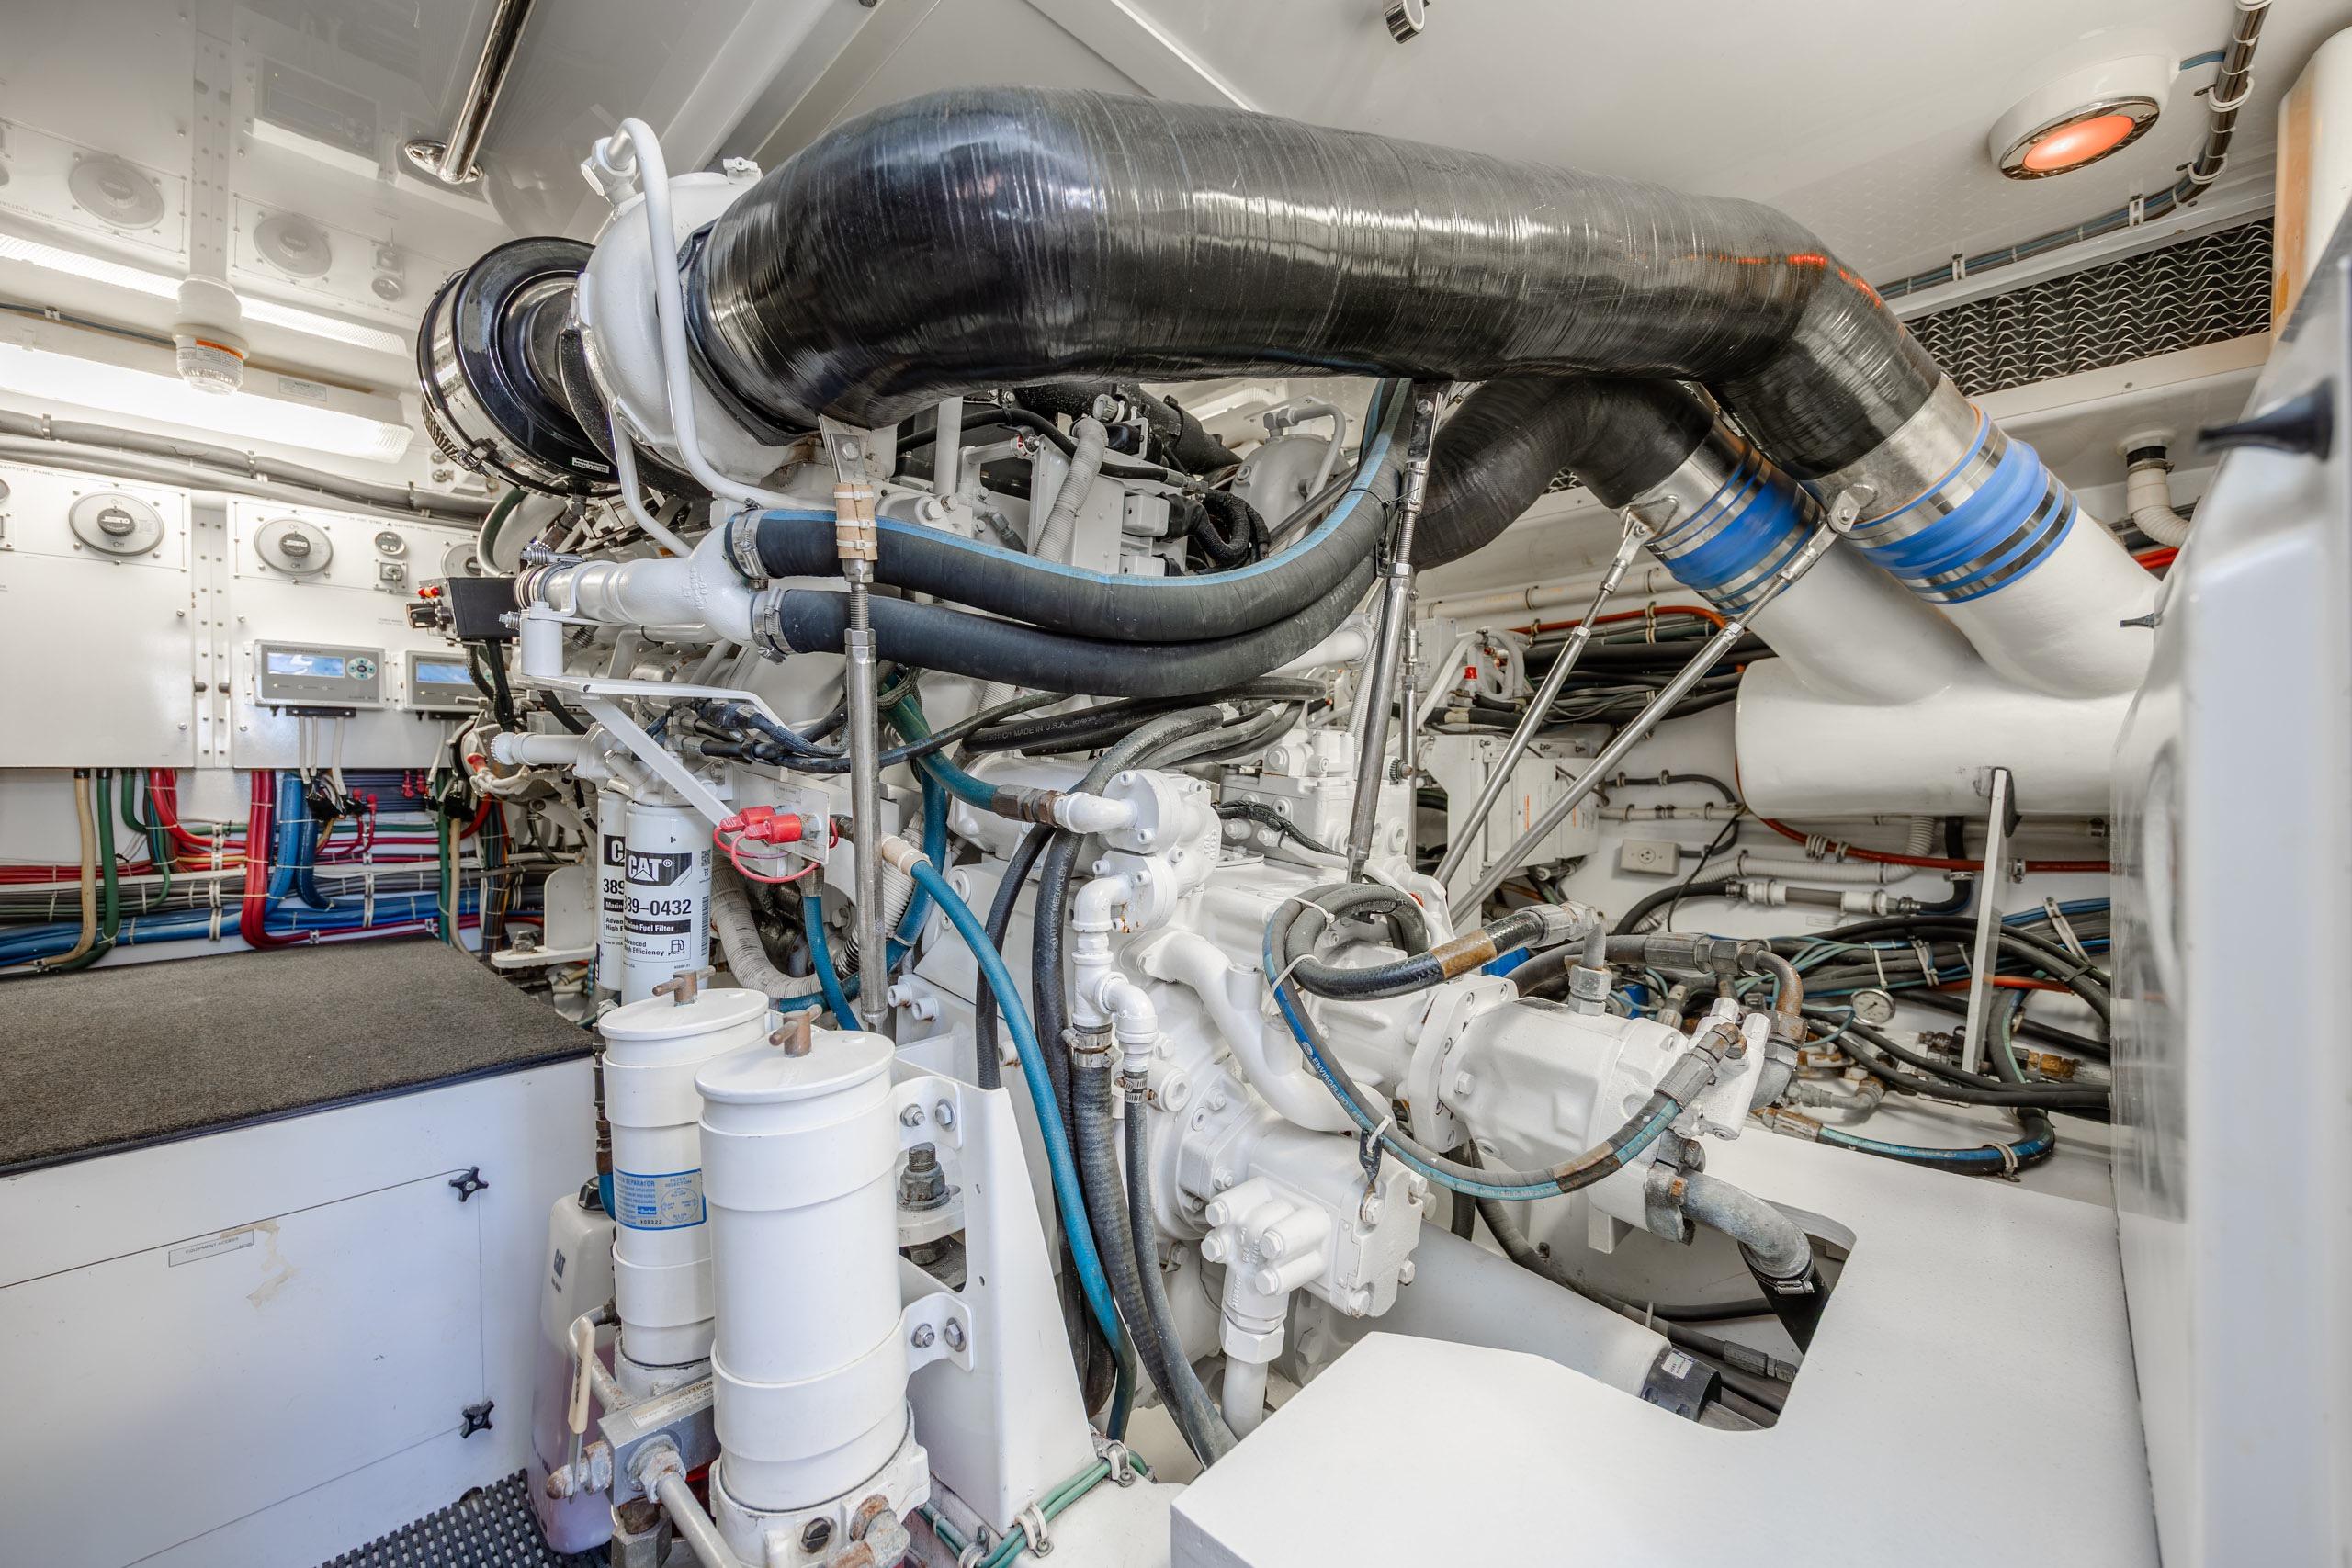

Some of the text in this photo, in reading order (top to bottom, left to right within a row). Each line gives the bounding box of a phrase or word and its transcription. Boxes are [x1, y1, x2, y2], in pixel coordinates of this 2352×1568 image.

[1013, 726, 1035, 738] MADE
[1035, 725, 1044, 734] IN
[1045, 721, 1069, 732] U.S.A.
[628, 854, 662, 882] CAT
[605, 923, 619, 932] High
[654, 924, 674, 932] Filter
[632, 947, 665, 956] Efficiency
[1312, 1057, 1349, 1106] ENVIROFLUID
[625, 1179, 655, 1187] SEPARATOR
